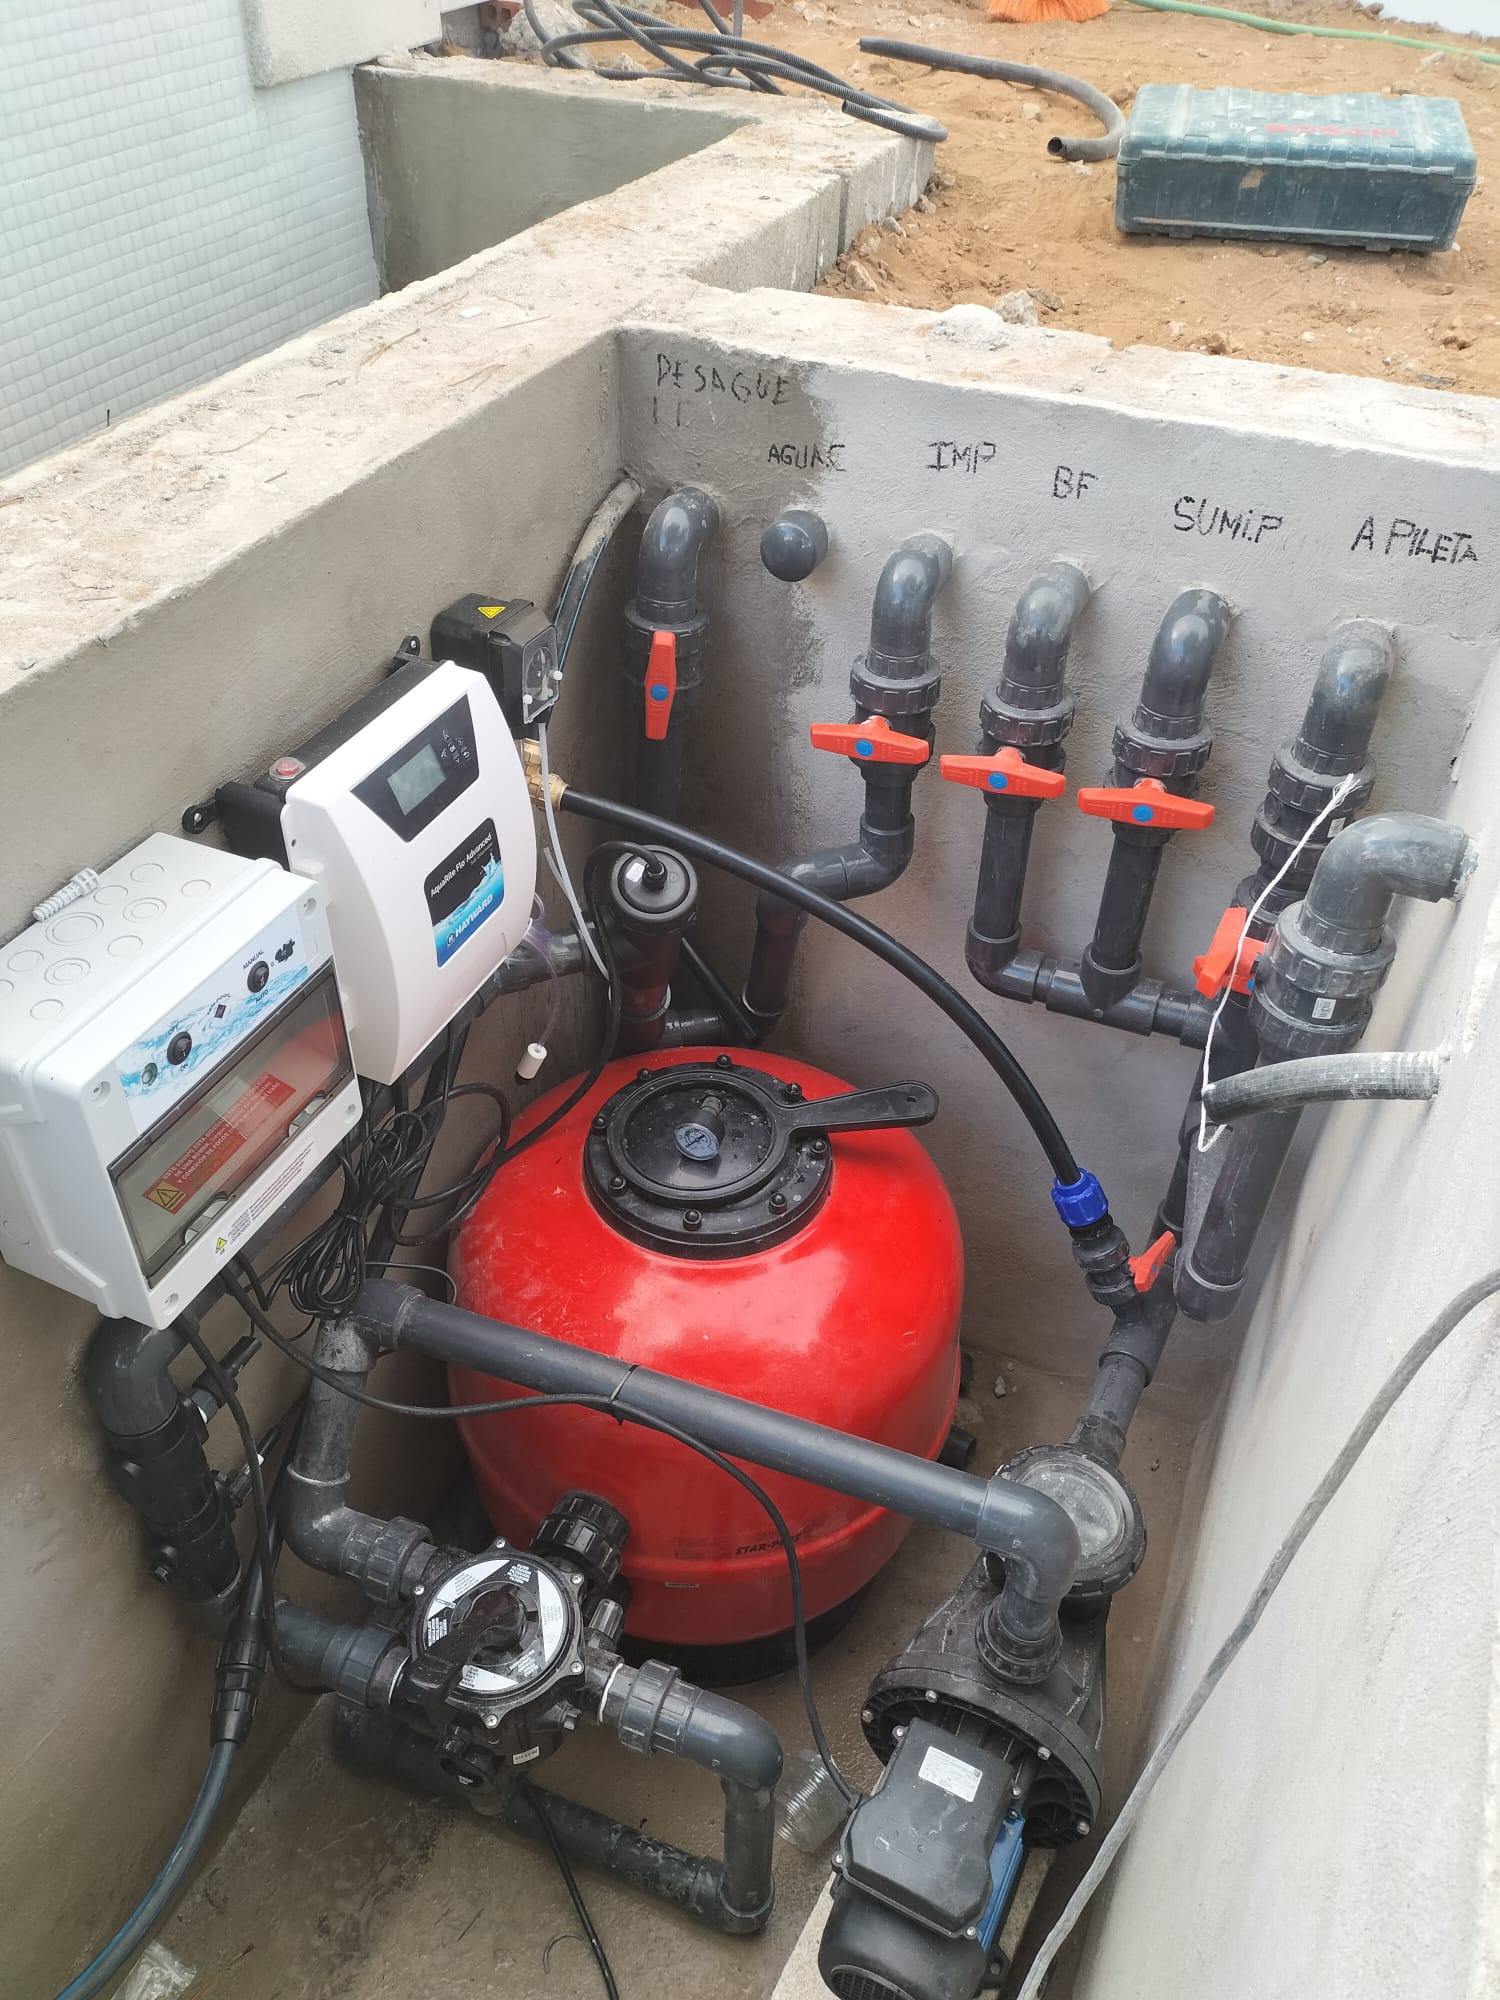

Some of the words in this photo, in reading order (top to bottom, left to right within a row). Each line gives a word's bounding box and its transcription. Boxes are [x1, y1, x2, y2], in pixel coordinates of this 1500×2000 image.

[656, 352, 790, 406] DESAGUE
[926, 440, 997, 474] IMP
[1052, 465, 1099, 499] BF
[1350, 515, 1374, 551] A
[1385, 518, 1478, 564] PILETA
[430, 869, 456, 898] AquaRite
[466, 832, 492, 862] Advanced
[455, 893, 493, 938] HAYWARD
[255, 989, 269, 1004] AUTO
